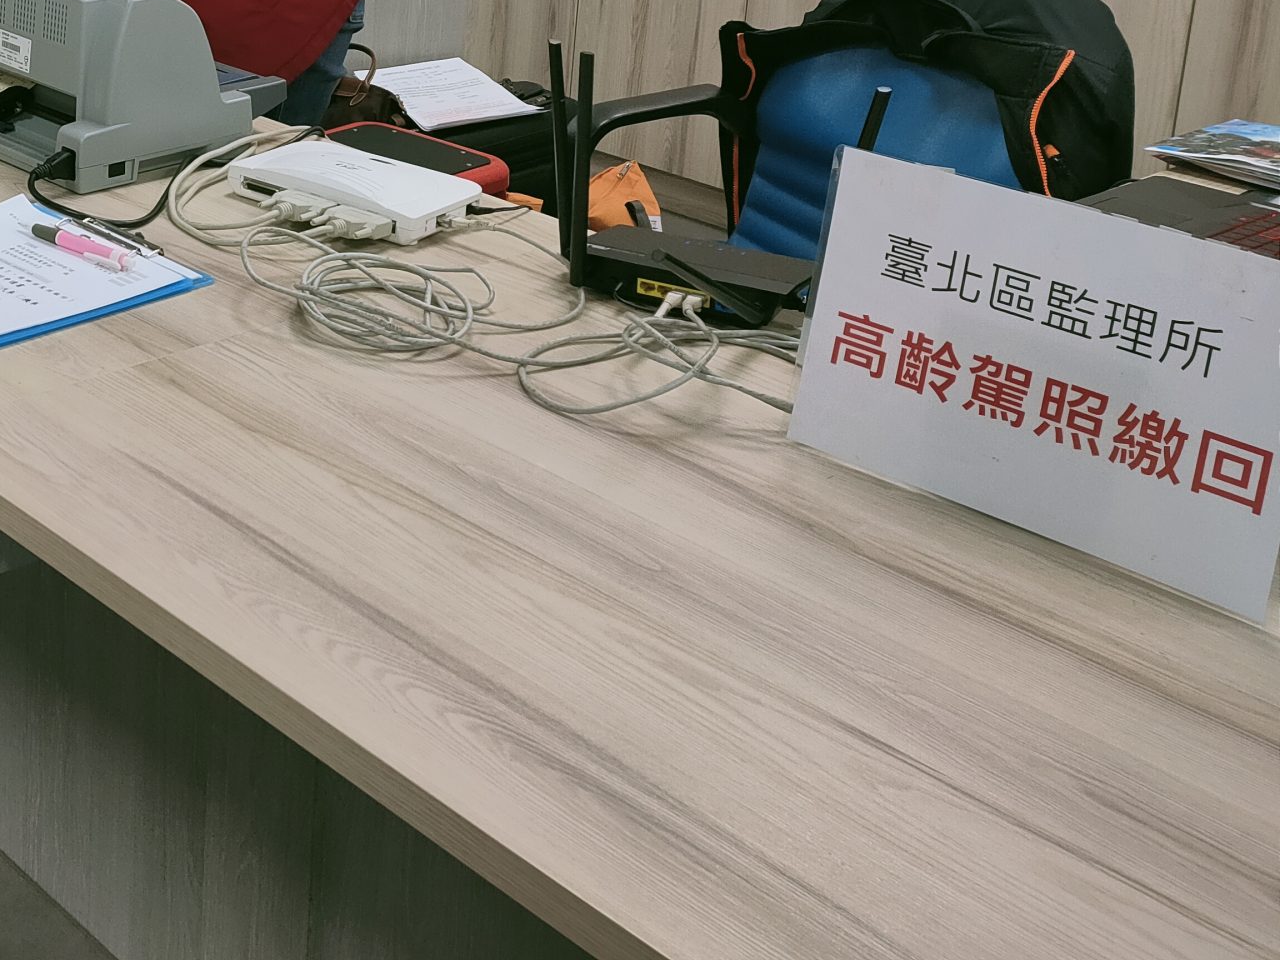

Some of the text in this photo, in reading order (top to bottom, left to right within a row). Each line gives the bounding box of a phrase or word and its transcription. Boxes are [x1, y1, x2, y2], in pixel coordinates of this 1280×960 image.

[881, 234, 1223, 377] 臺北區監理所
[831, 311, 1273, 515] 高齡駕照繳回
